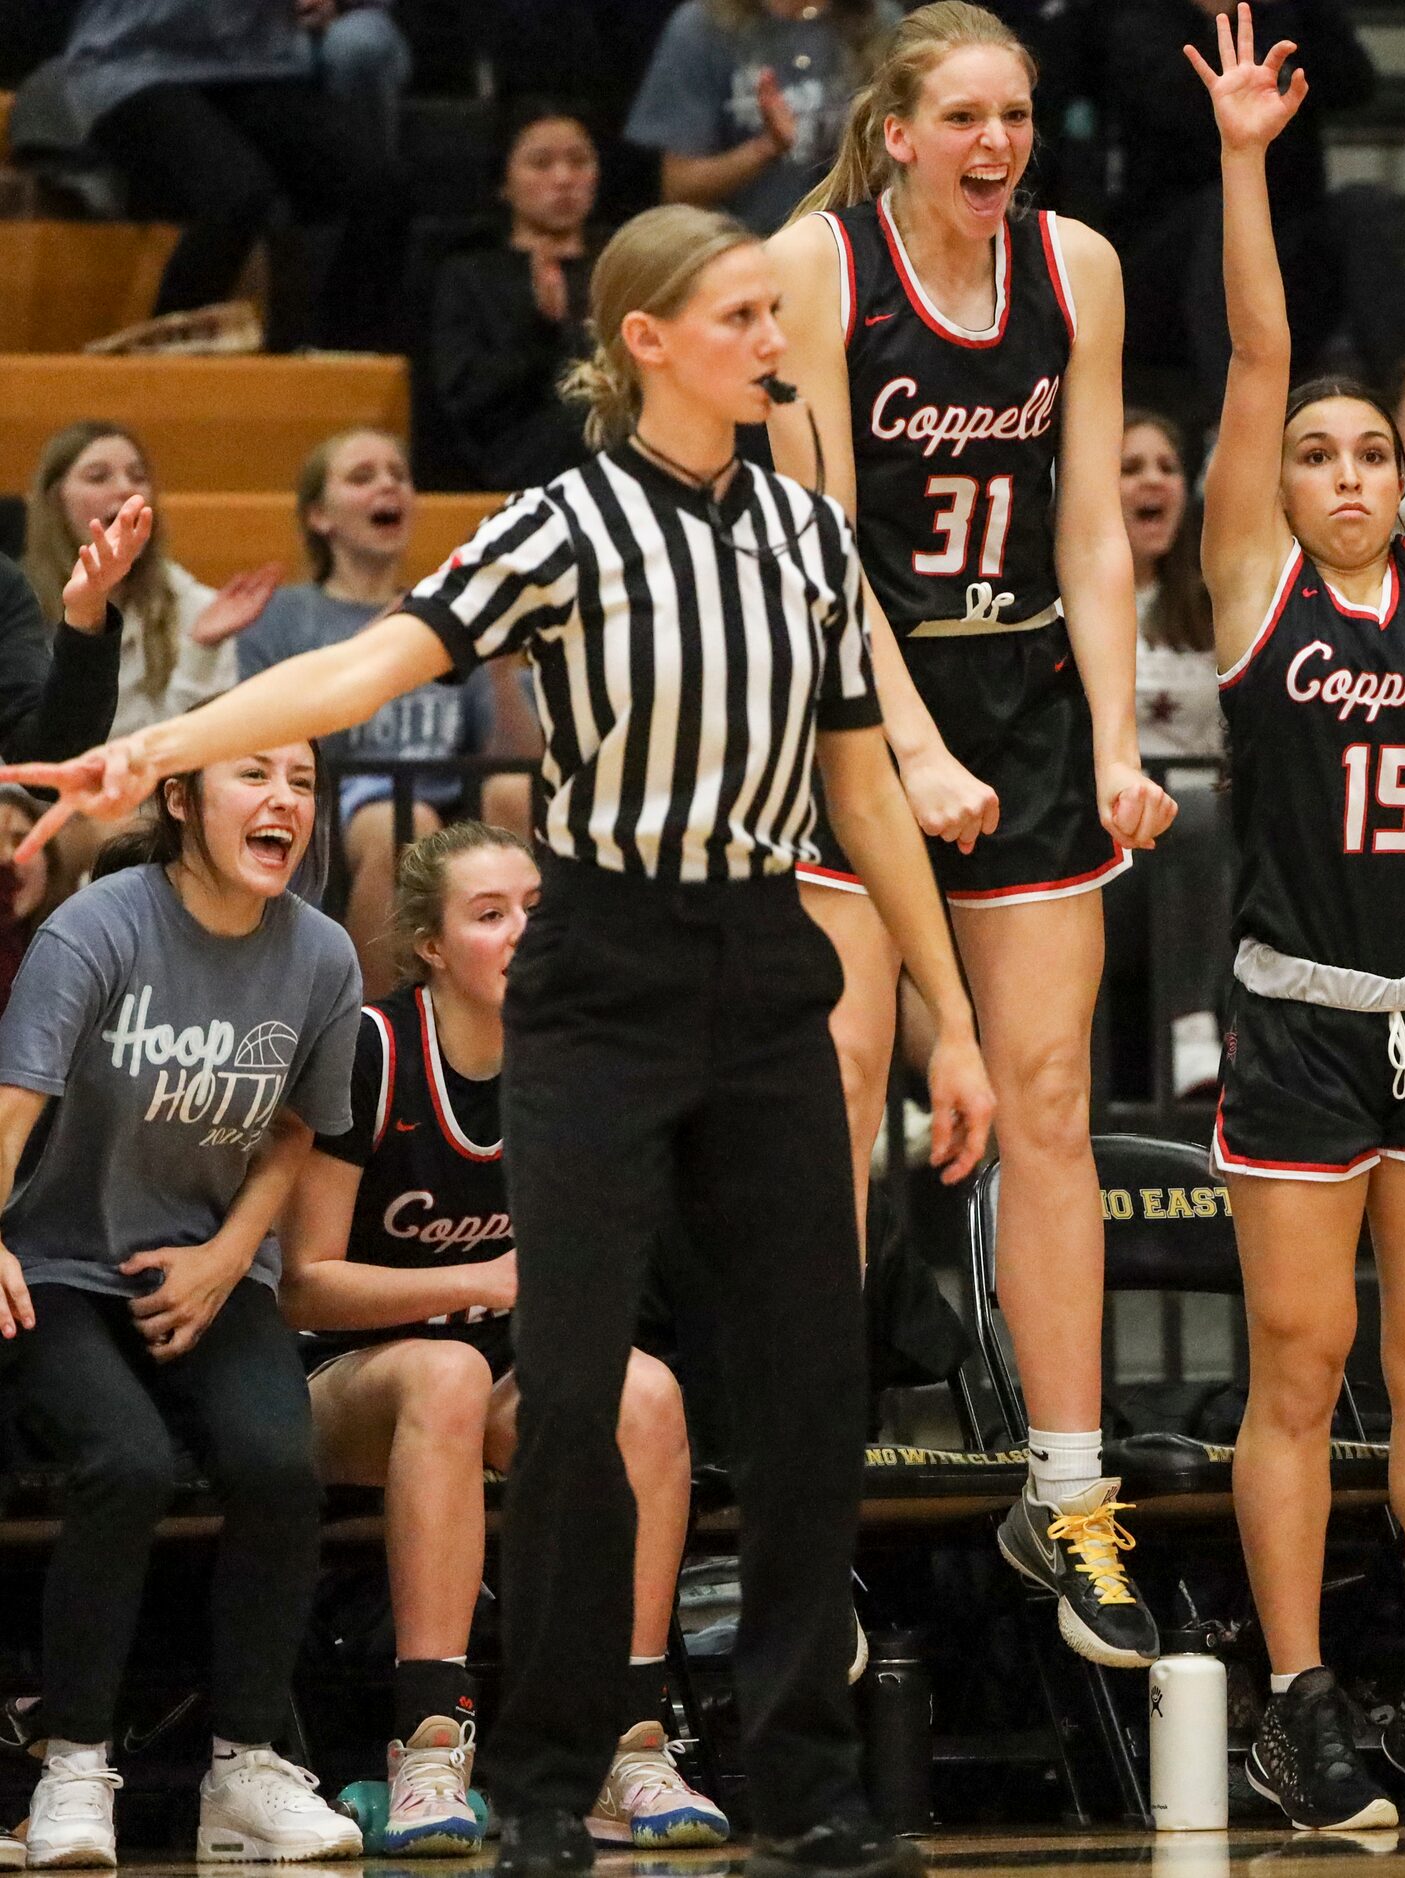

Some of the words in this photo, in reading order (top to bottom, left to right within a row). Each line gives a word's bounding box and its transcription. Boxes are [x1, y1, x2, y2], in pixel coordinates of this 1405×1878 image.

[872, 374, 1060, 457] Coppell
[911, 474, 1014, 578] 31
[101, 984, 236, 1108] Hoop
[383, 1189, 516, 1254] Copp
[1139, 1186, 1233, 1219] EAST
